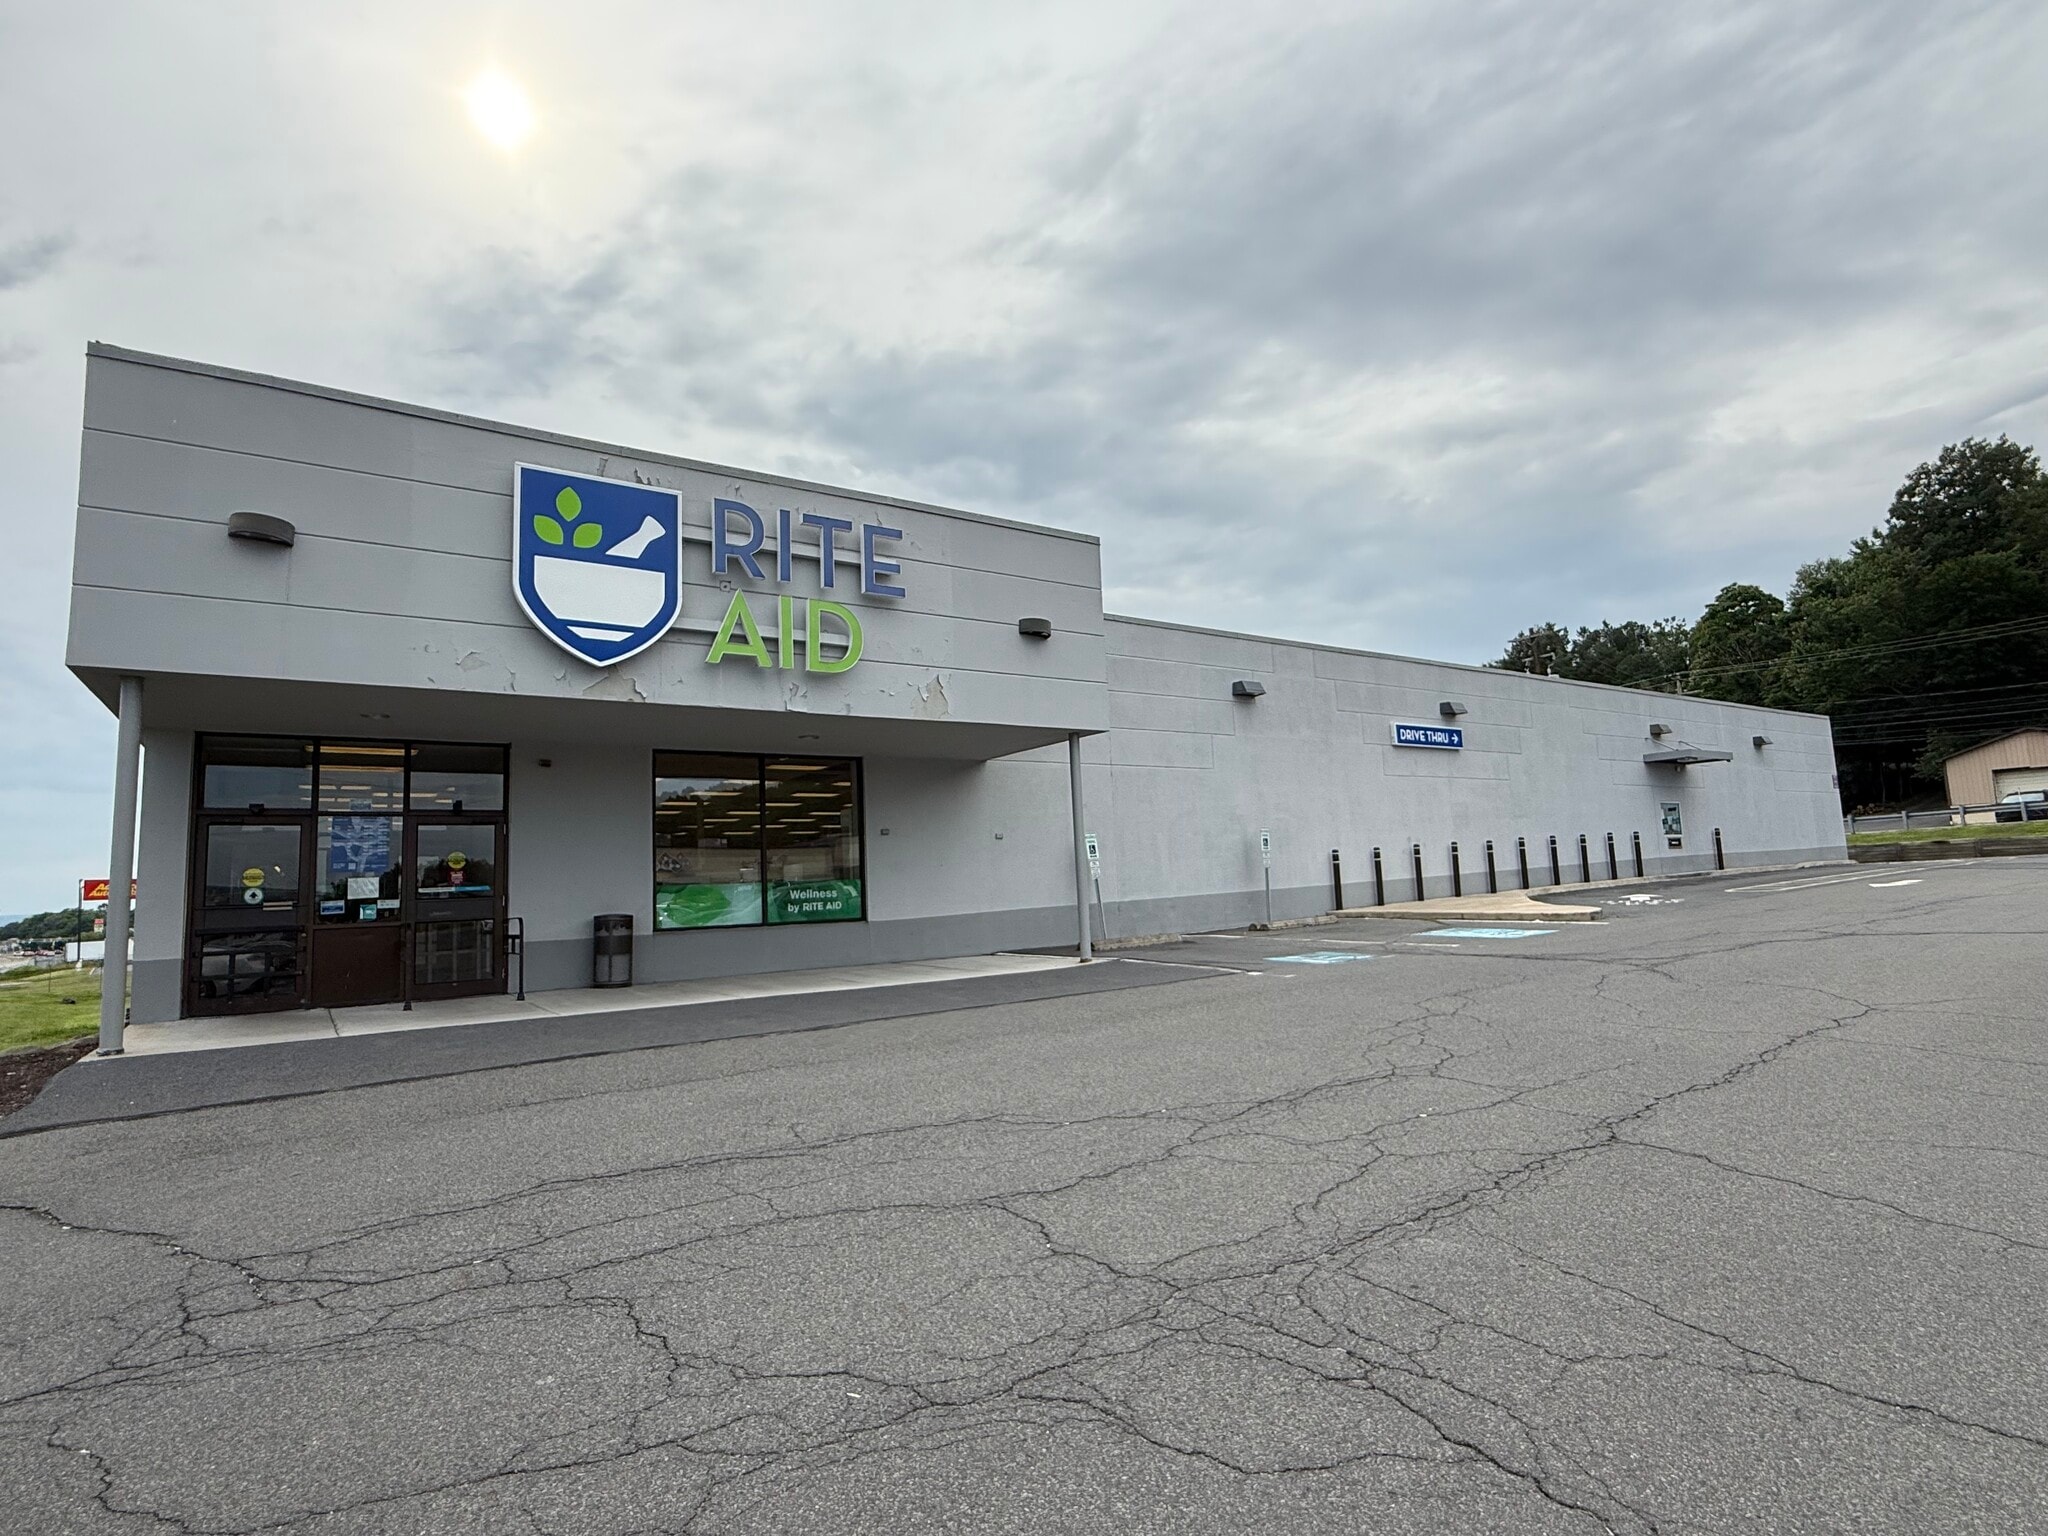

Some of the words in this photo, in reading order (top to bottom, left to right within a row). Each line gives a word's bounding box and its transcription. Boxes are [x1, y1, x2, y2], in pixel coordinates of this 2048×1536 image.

[712, 498, 906, 599] RITE
[705, 588, 864, 673] AID
[1399, 728, 1426, 742] DRIVE
[1426, 730, 1449, 744] THRU
[789, 889, 838, 899] Wellness
[788, 903, 800, 913] by
[802, 901, 824, 911] RITE
[826, 900, 842, 910] AID
